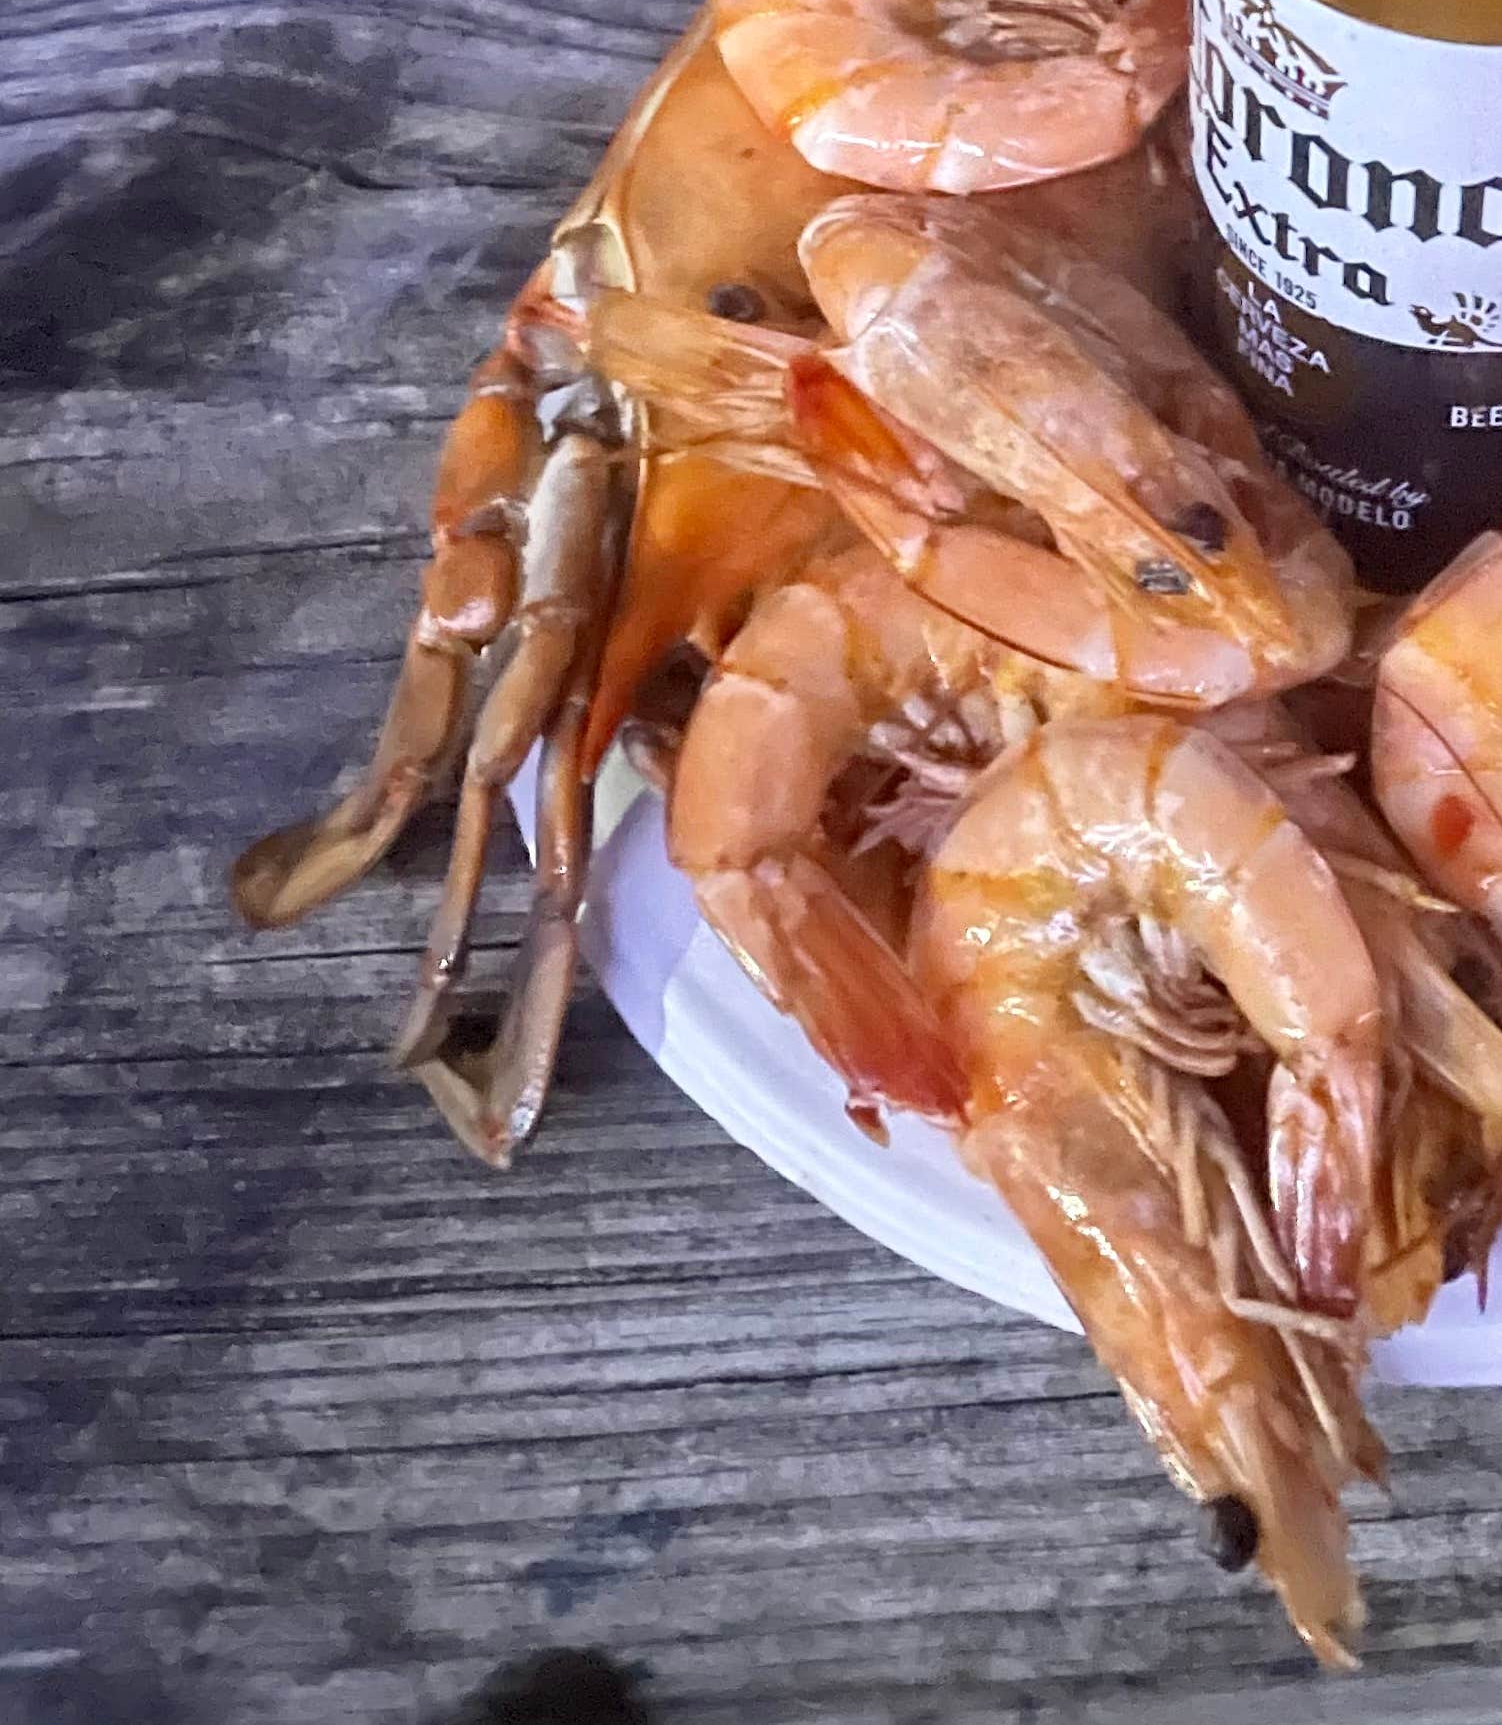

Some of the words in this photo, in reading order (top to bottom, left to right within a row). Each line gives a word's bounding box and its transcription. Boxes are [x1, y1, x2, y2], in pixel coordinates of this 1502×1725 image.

[1205, 116, 1395, 306] Extra
[1248, 281, 1281, 325] LA
[1275, 271, 1317, 310] 1925
[1388, 480, 1432, 510] by
